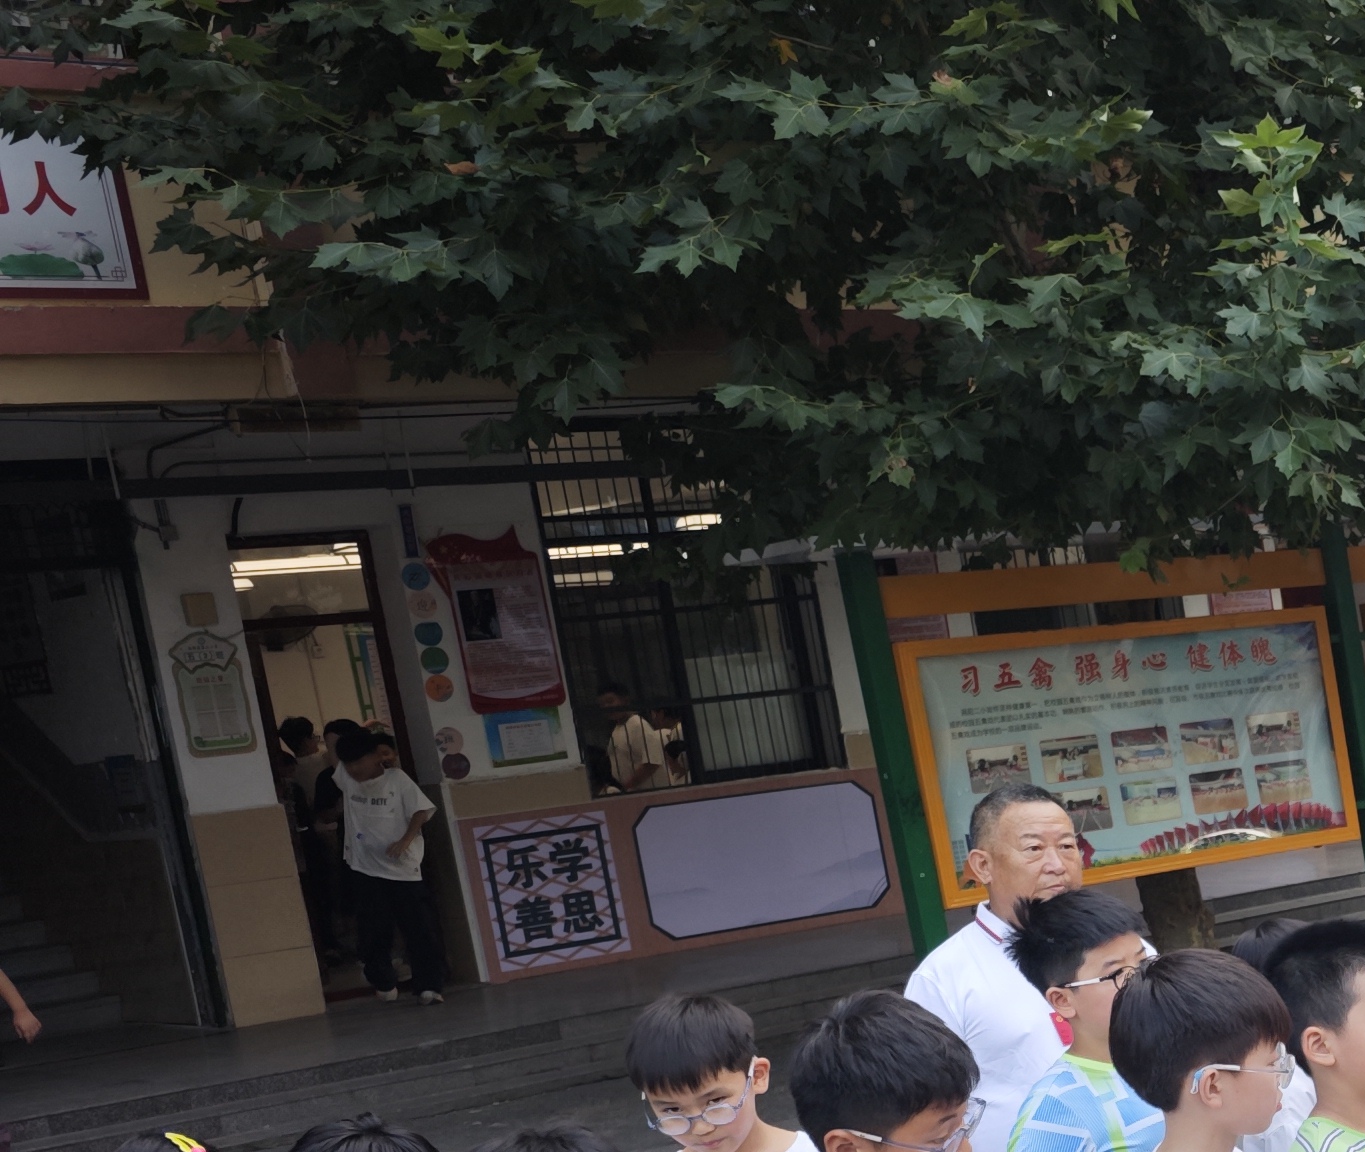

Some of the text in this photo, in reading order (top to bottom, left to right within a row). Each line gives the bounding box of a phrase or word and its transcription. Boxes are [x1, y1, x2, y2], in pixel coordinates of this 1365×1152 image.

[0, 160, 78, 218] 人
[960, 656, 1056, 697] 习五禽
[1074, 649, 1168, 686] 强身心
[506, 837, 593, 889] 乐学
[513, 890, 605, 943] 善思
